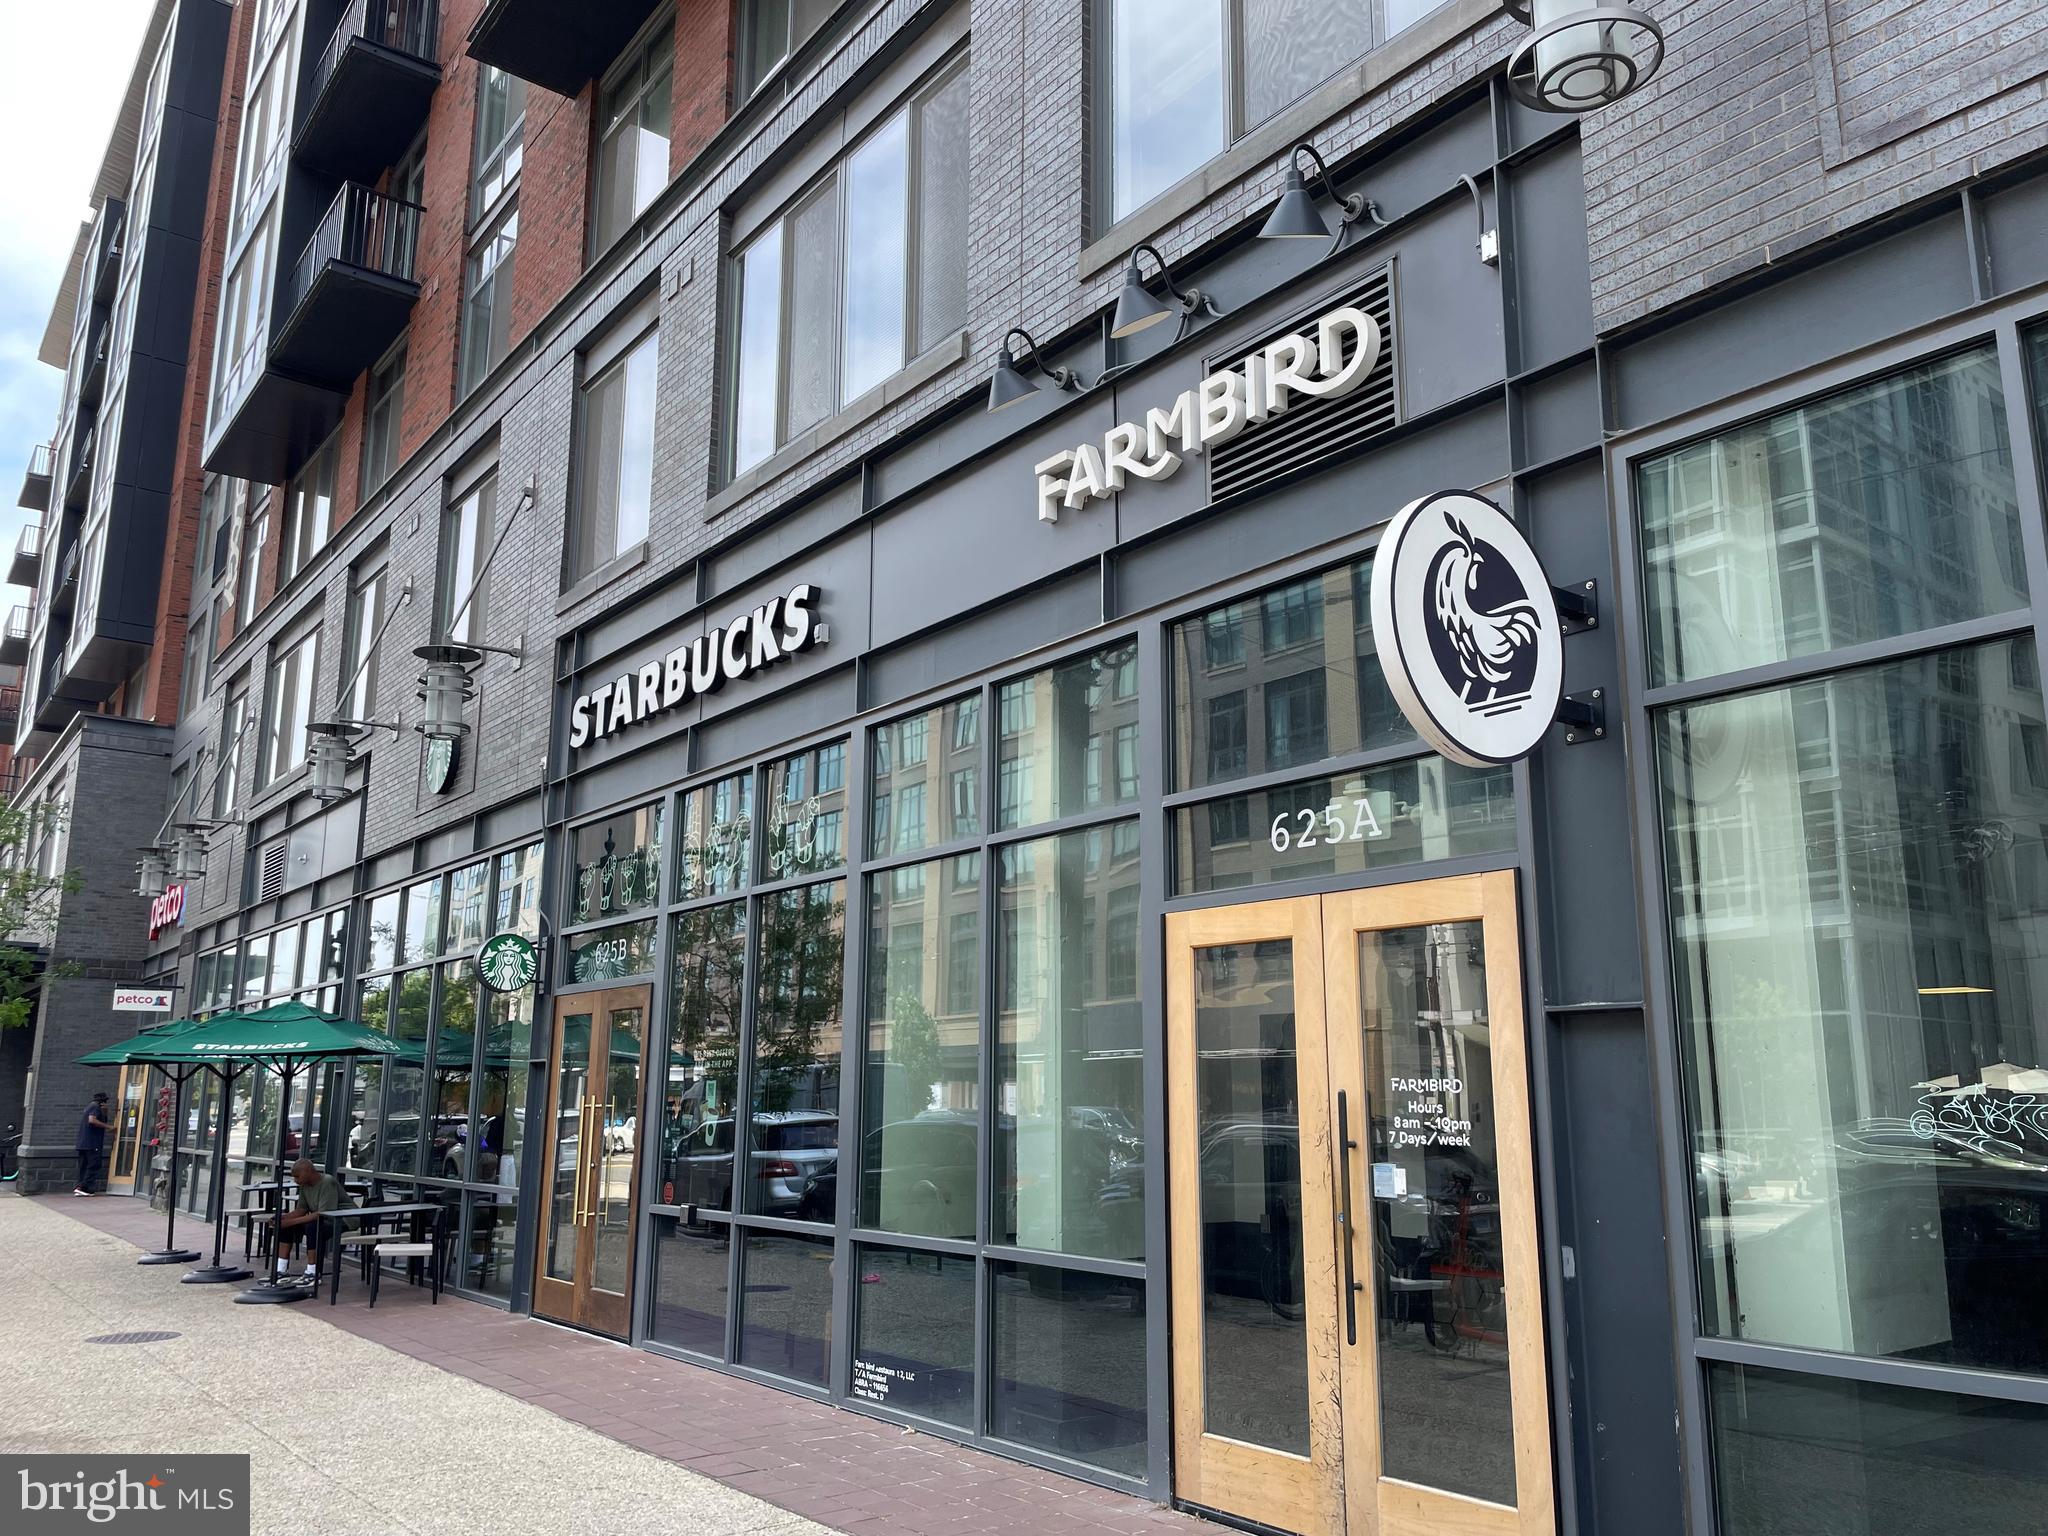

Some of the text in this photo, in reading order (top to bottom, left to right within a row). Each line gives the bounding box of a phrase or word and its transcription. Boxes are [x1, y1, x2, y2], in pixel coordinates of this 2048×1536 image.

[1034, 307, 1382, 524] FARMBIRD
[569, 584, 818, 749] STARBUCKS
[1271, 799, 1383, 852] 625A
[148, 884, 182, 940] petco
[595, 938, 627, 964] 625B
[116, 995, 153, 1005] petco
[192, 1041, 309, 1050] STARBUCKS
[1391, 1077, 1463, 1093] FARMBIRD
[1408, 1101, 1443, 1114] Hours
[1393, 1116, 1420, 1129] 8am
[1435, 1116, 1472, 1132] 10pm
[1388, 1131, 1471, 1147] 7 Days/week
